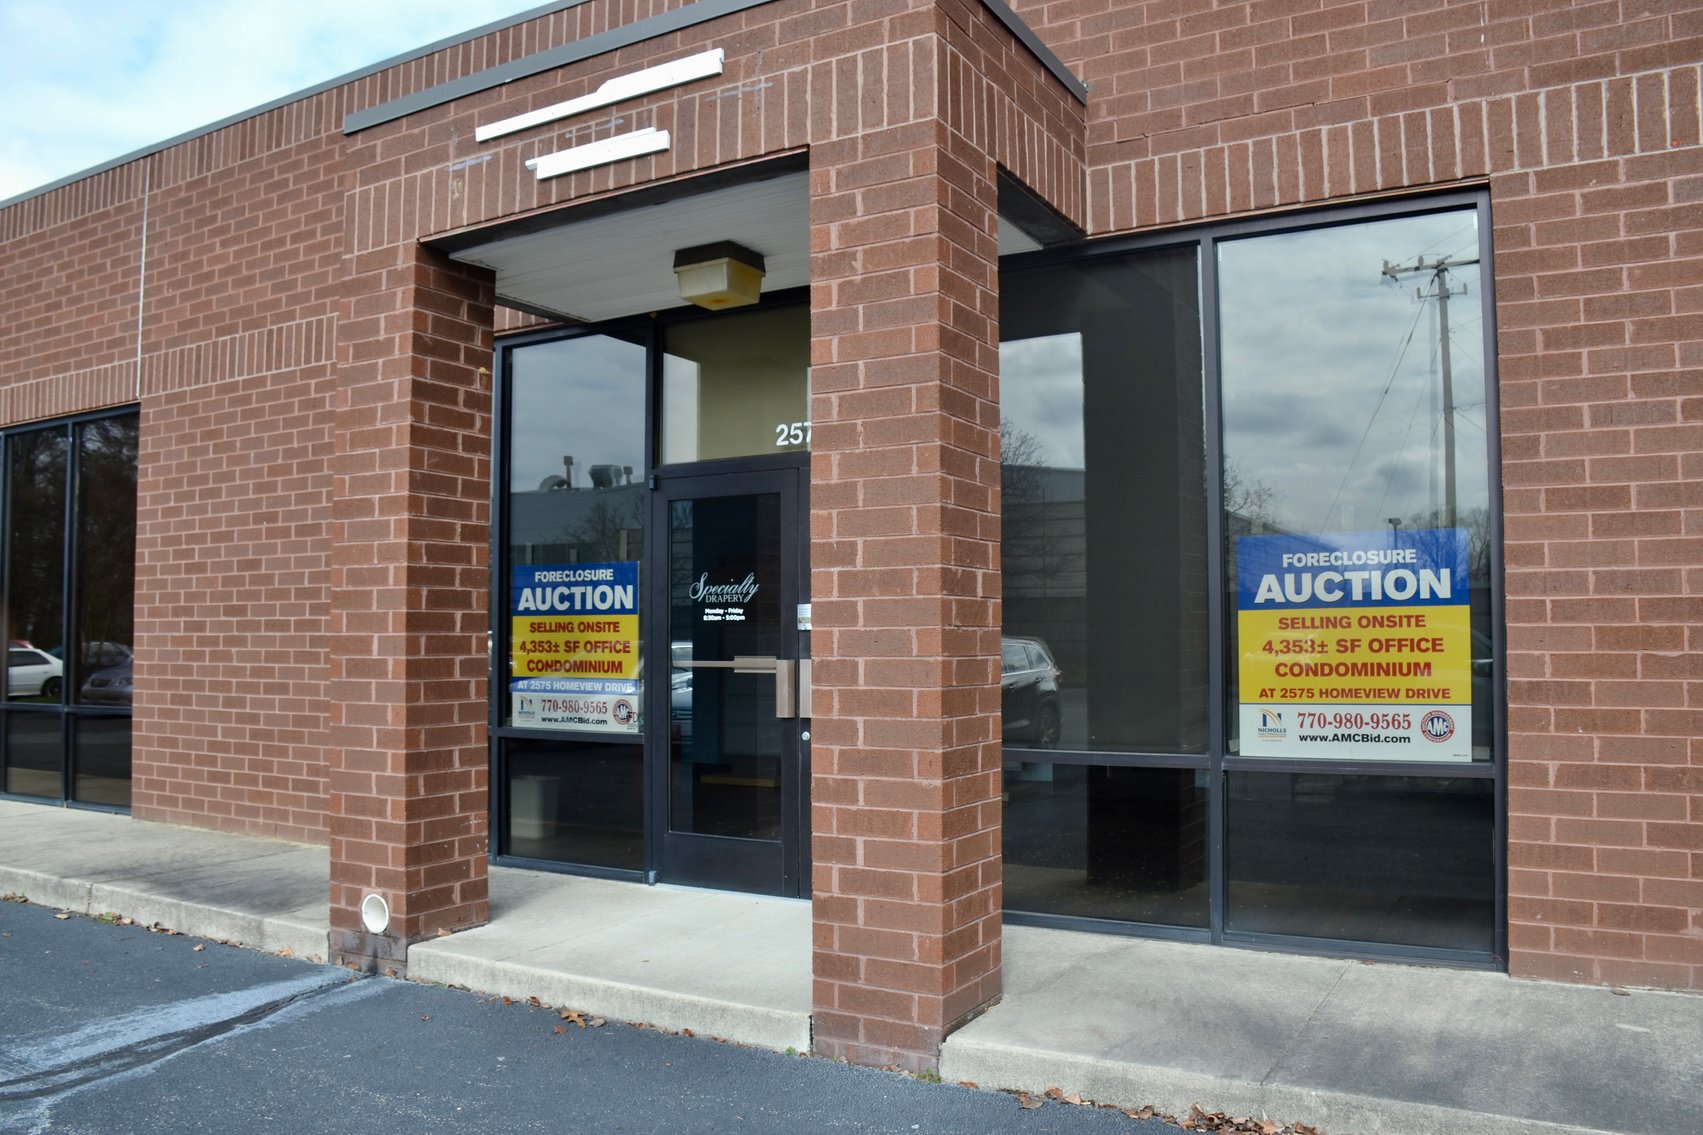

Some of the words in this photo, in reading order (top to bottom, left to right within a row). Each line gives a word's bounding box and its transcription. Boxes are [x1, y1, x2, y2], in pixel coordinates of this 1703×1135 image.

[1282, 549, 1417, 568] FORECLOSURE
[534, 569, 614, 583] FORECLOSURE
[689, 572, 760, 604] Specialty
[1254, 568, 1451, 604] AUCTION
[517, 585, 634, 611] AUCTION
[705, 594, 745, 604] DRAPERY
[529, 622, 574, 633] SELLING
[577, 621, 620, 633] ONSITE
[1278, 617, 1352, 630] SELLING
[1357, 615, 1426, 628] ONSITE
[519, 640, 560, 656] 4,353±
[563, 640, 581, 653] SF
[584, 640, 631, 653] OFFICE
[1262, 640, 1329, 657] 4,353±
[1335, 638, 1362, 653] SF
[1368, 638, 1445, 653] OFFICE
[526, 660, 623, 673] CONDOMINIUM
[1274, 662, 1432, 677] CONDOMINIUM
[517, 681, 529, 689] AT
[530, 681, 551, 690] 2575
[553, 681, 603, 691] HOMEVIEW
[605, 682, 635, 692] DRIVE
[1258, 688, 1276, 698] AT
[1280, 688, 1315, 699] 2575
[1319, 688, 1401, 699] HOMEVIEW
[1405, 688, 1451, 699] DRIVE
[541, 699, 608, 715] 770-980-9565
[541, 716, 608, 726] www.AMCBid.com
[1297, 712, 1412, 730] 770-980-9565
[1427, 717, 1450, 737] AMC
[1298, 733, 1411, 744] www.AMCBid.com
